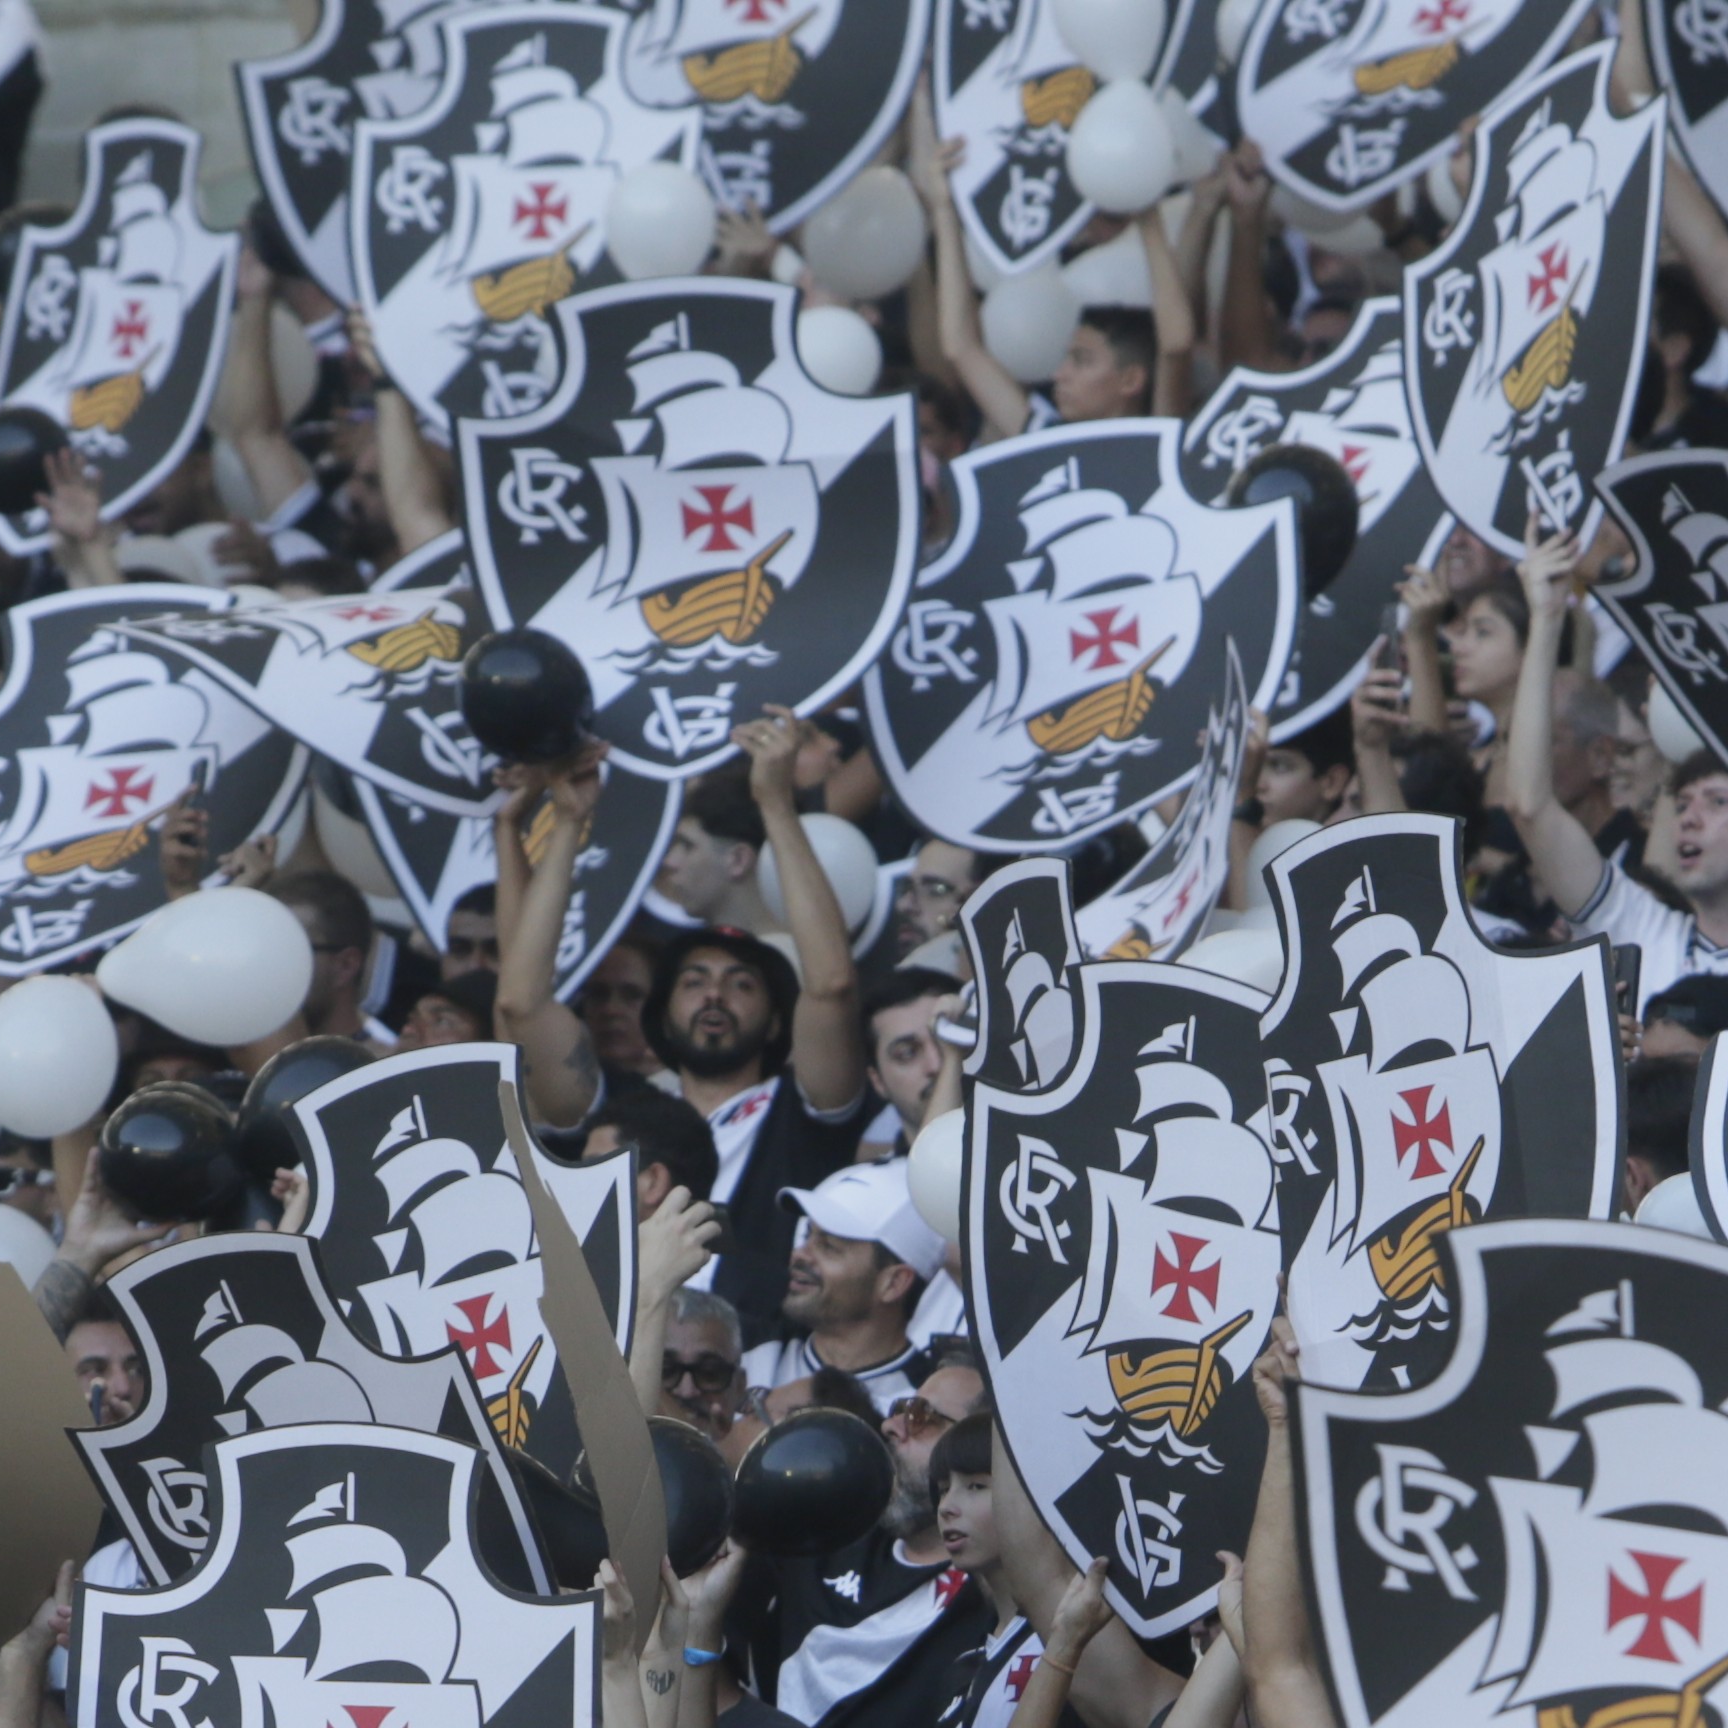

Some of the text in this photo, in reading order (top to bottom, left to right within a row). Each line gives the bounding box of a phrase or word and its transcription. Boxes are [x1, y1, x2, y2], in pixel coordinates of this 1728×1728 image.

[279, 76, 353, 164] CR
[1325, 118, 1407, 188] VG
[376, 146, 446, 231] CR
[999, 165, 1060, 250] VG
[24, 255, 76, 341] CR
[1423, 267, 1475, 366] CR
[498, 447, 588, 543] CR
[891, 598, 978, 692] CR
[1642, 602, 1728, 687] CR
[642, 682, 738, 758] VG
[1031, 771, 1120, 835] VG
[999, 1133, 1078, 1264] CR
[1114, 1473, 1187, 1600] VG
[1354, 1442, 1479, 1600] CR
